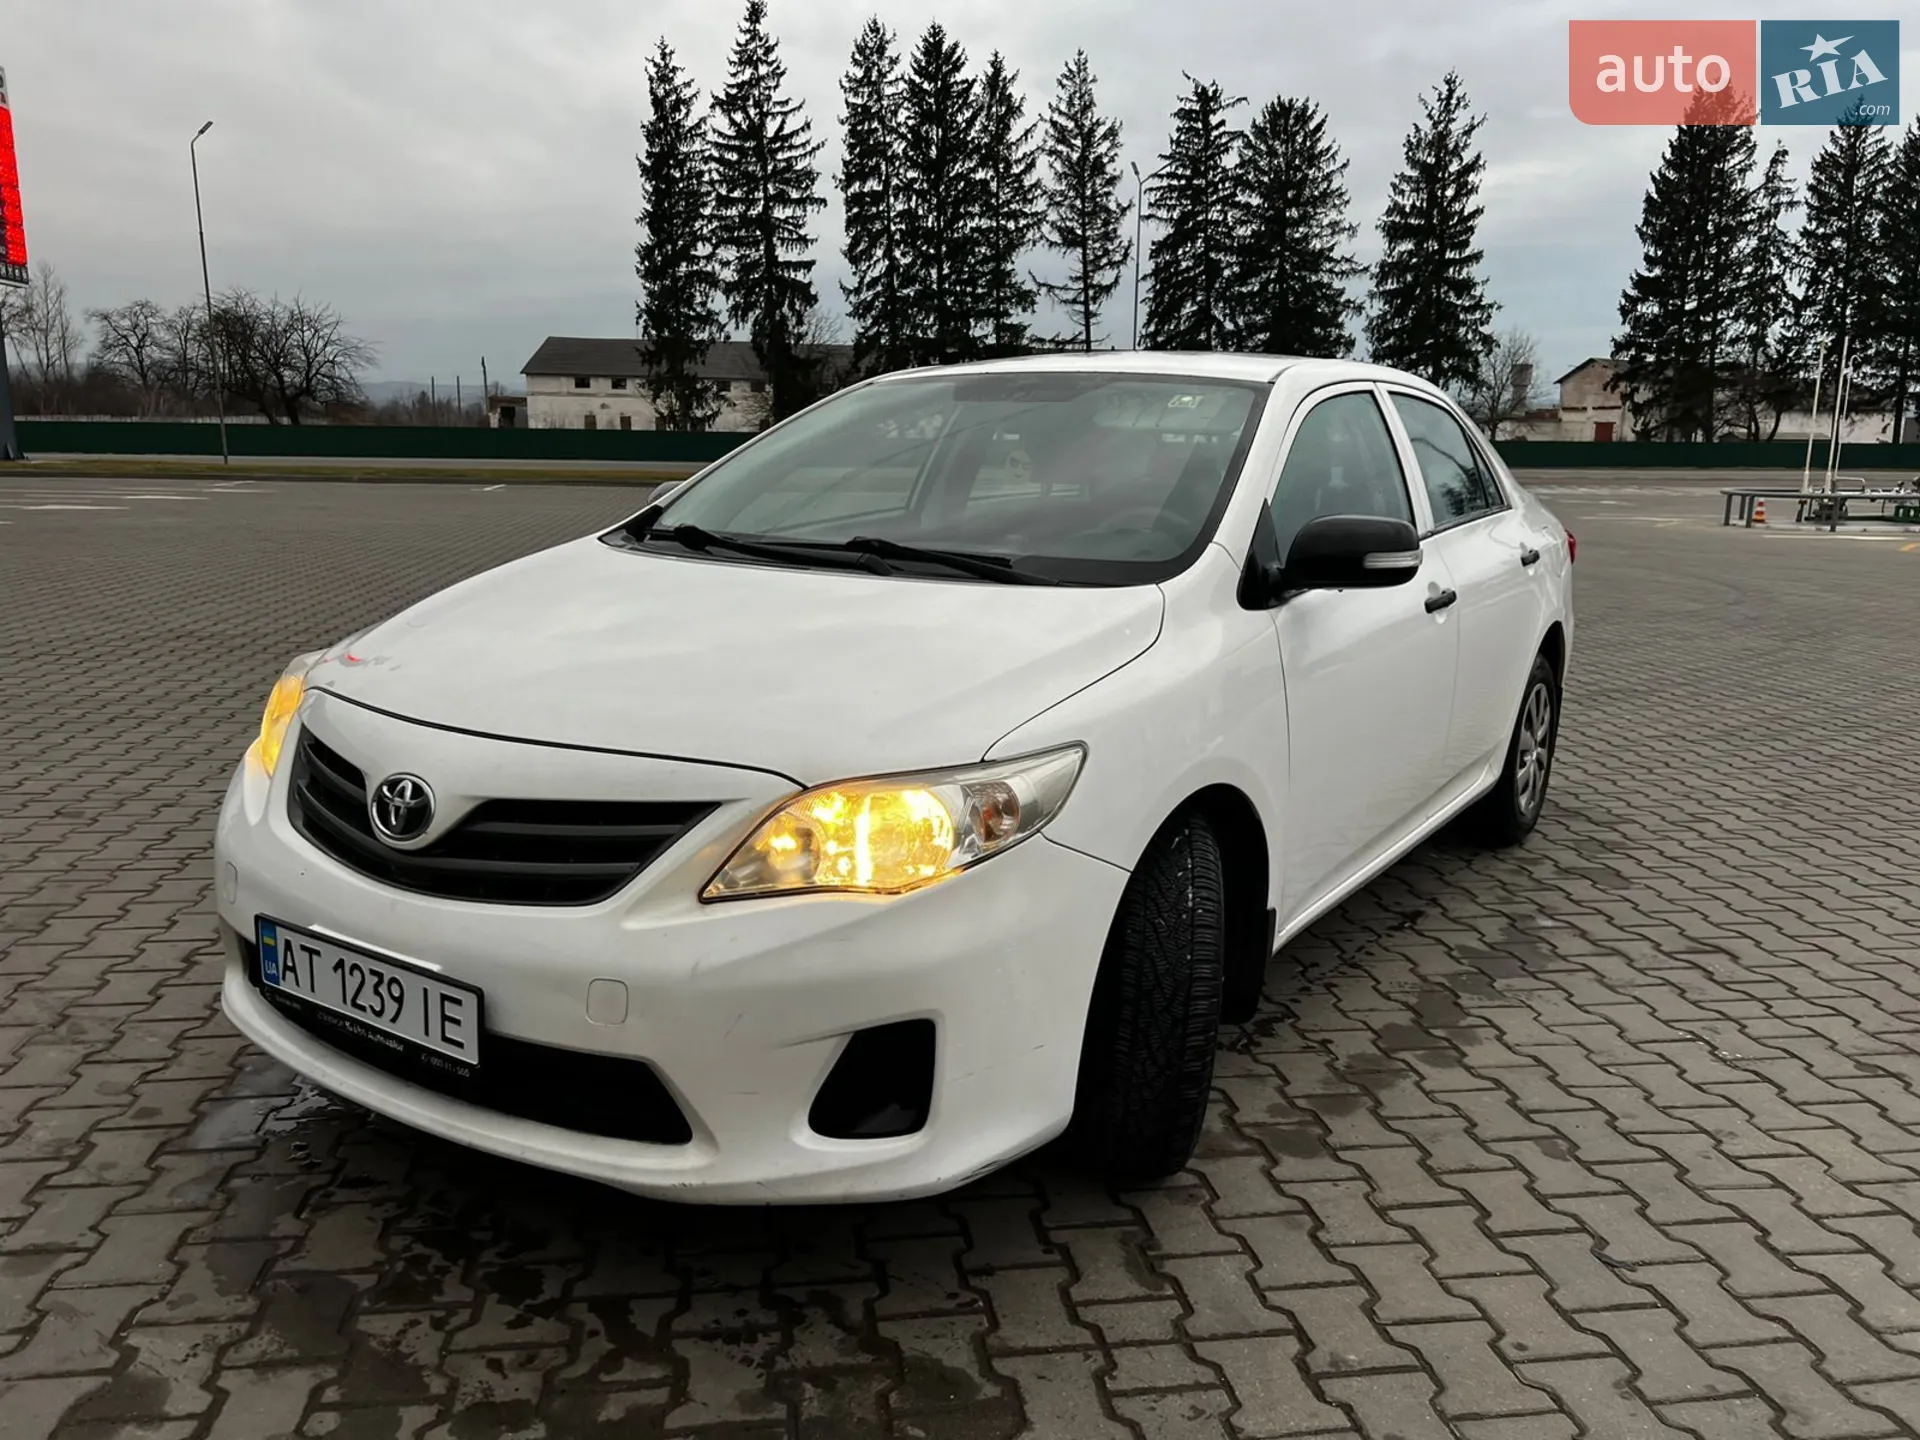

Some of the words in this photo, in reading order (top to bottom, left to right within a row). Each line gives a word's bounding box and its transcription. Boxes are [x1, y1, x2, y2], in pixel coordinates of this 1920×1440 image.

[265, 959, 278, 976] UA
[281, 938, 321, 994] AT
[332, 957, 405, 1024] 1239
[422, 986, 465, 1050] IE
